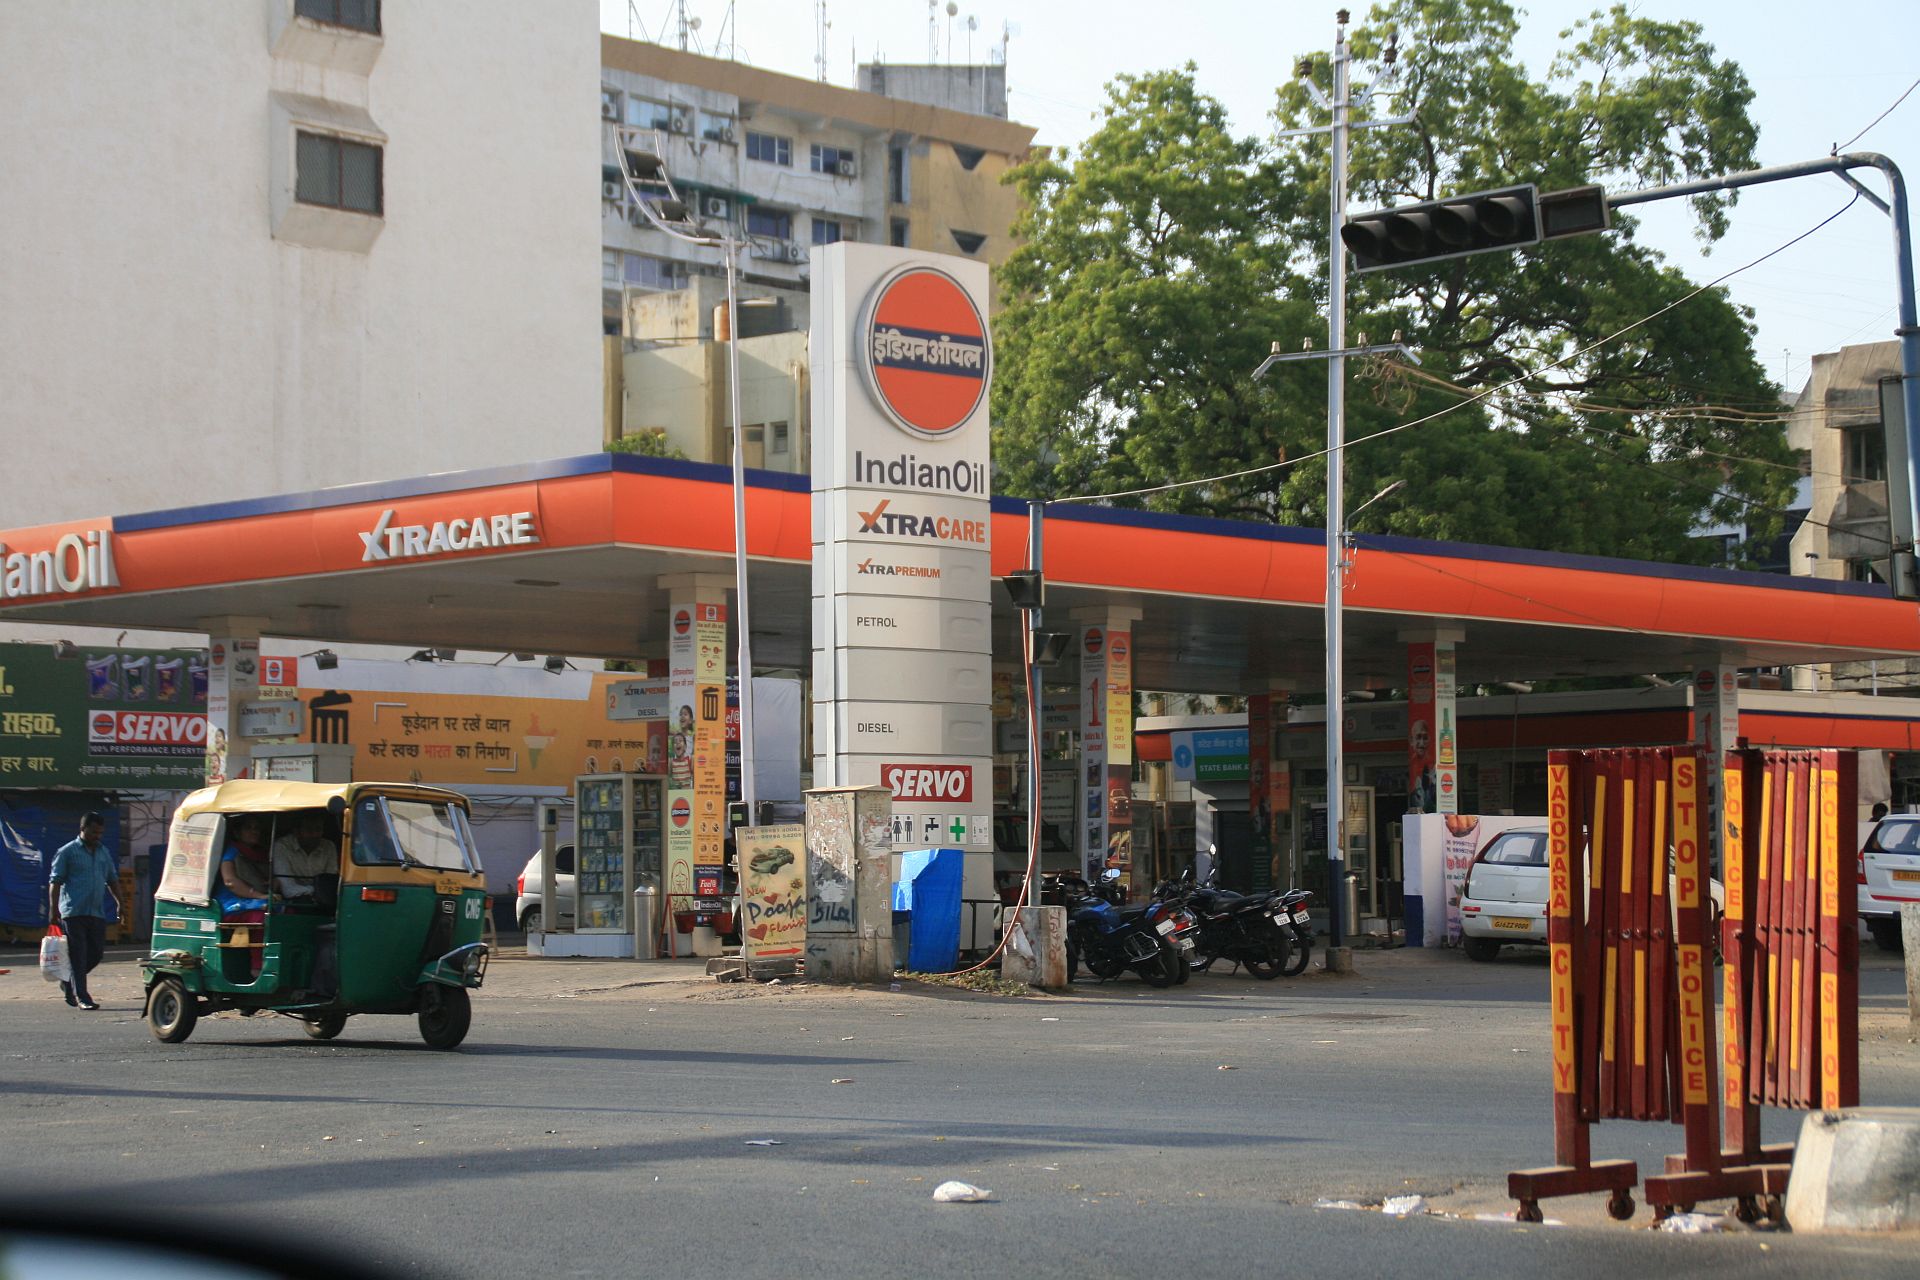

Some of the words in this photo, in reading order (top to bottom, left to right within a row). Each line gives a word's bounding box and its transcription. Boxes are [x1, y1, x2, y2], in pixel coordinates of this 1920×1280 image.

[874, 328, 982, 369] इंडियनऑयल
[855, 451, 984, 494] IndianOil
[359, 510, 538, 562] XTRACARE
[858, 499, 985, 543] XTRACARE
[857, 558, 941, 578] XTRAPREMIUM
[857, 617, 897, 627] PETROL
[610, 696, 616, 708] 2
[119, 714, 207, 742] SERVO
[402, 712, 439, 735] कूड़ेदान
[443, 717, 458, 730] पर
[462, 714, 481, 731] रखें
[857, 723, 893, 733] DIESEL
[368, 739, 387, 757] करें
[391, 744, 420, 757] स्वच्छ
[424, 744, 452, 758] भारत
[456, 746, 470, 758] का
[475, 741, 511, 760] निर्माण
[1550, 767, 1568, 910] VADODARA
[1677, 763, 1697, 902] STOP
[1726, 775, 1741, 907] POICE
[1823, 776, 1838, 910] POLICE
[465, 898, 480, 919] CNG
[1554, 948, 1572, 1089] CITY
[1682, 951, 1705, 1091] POLICE
